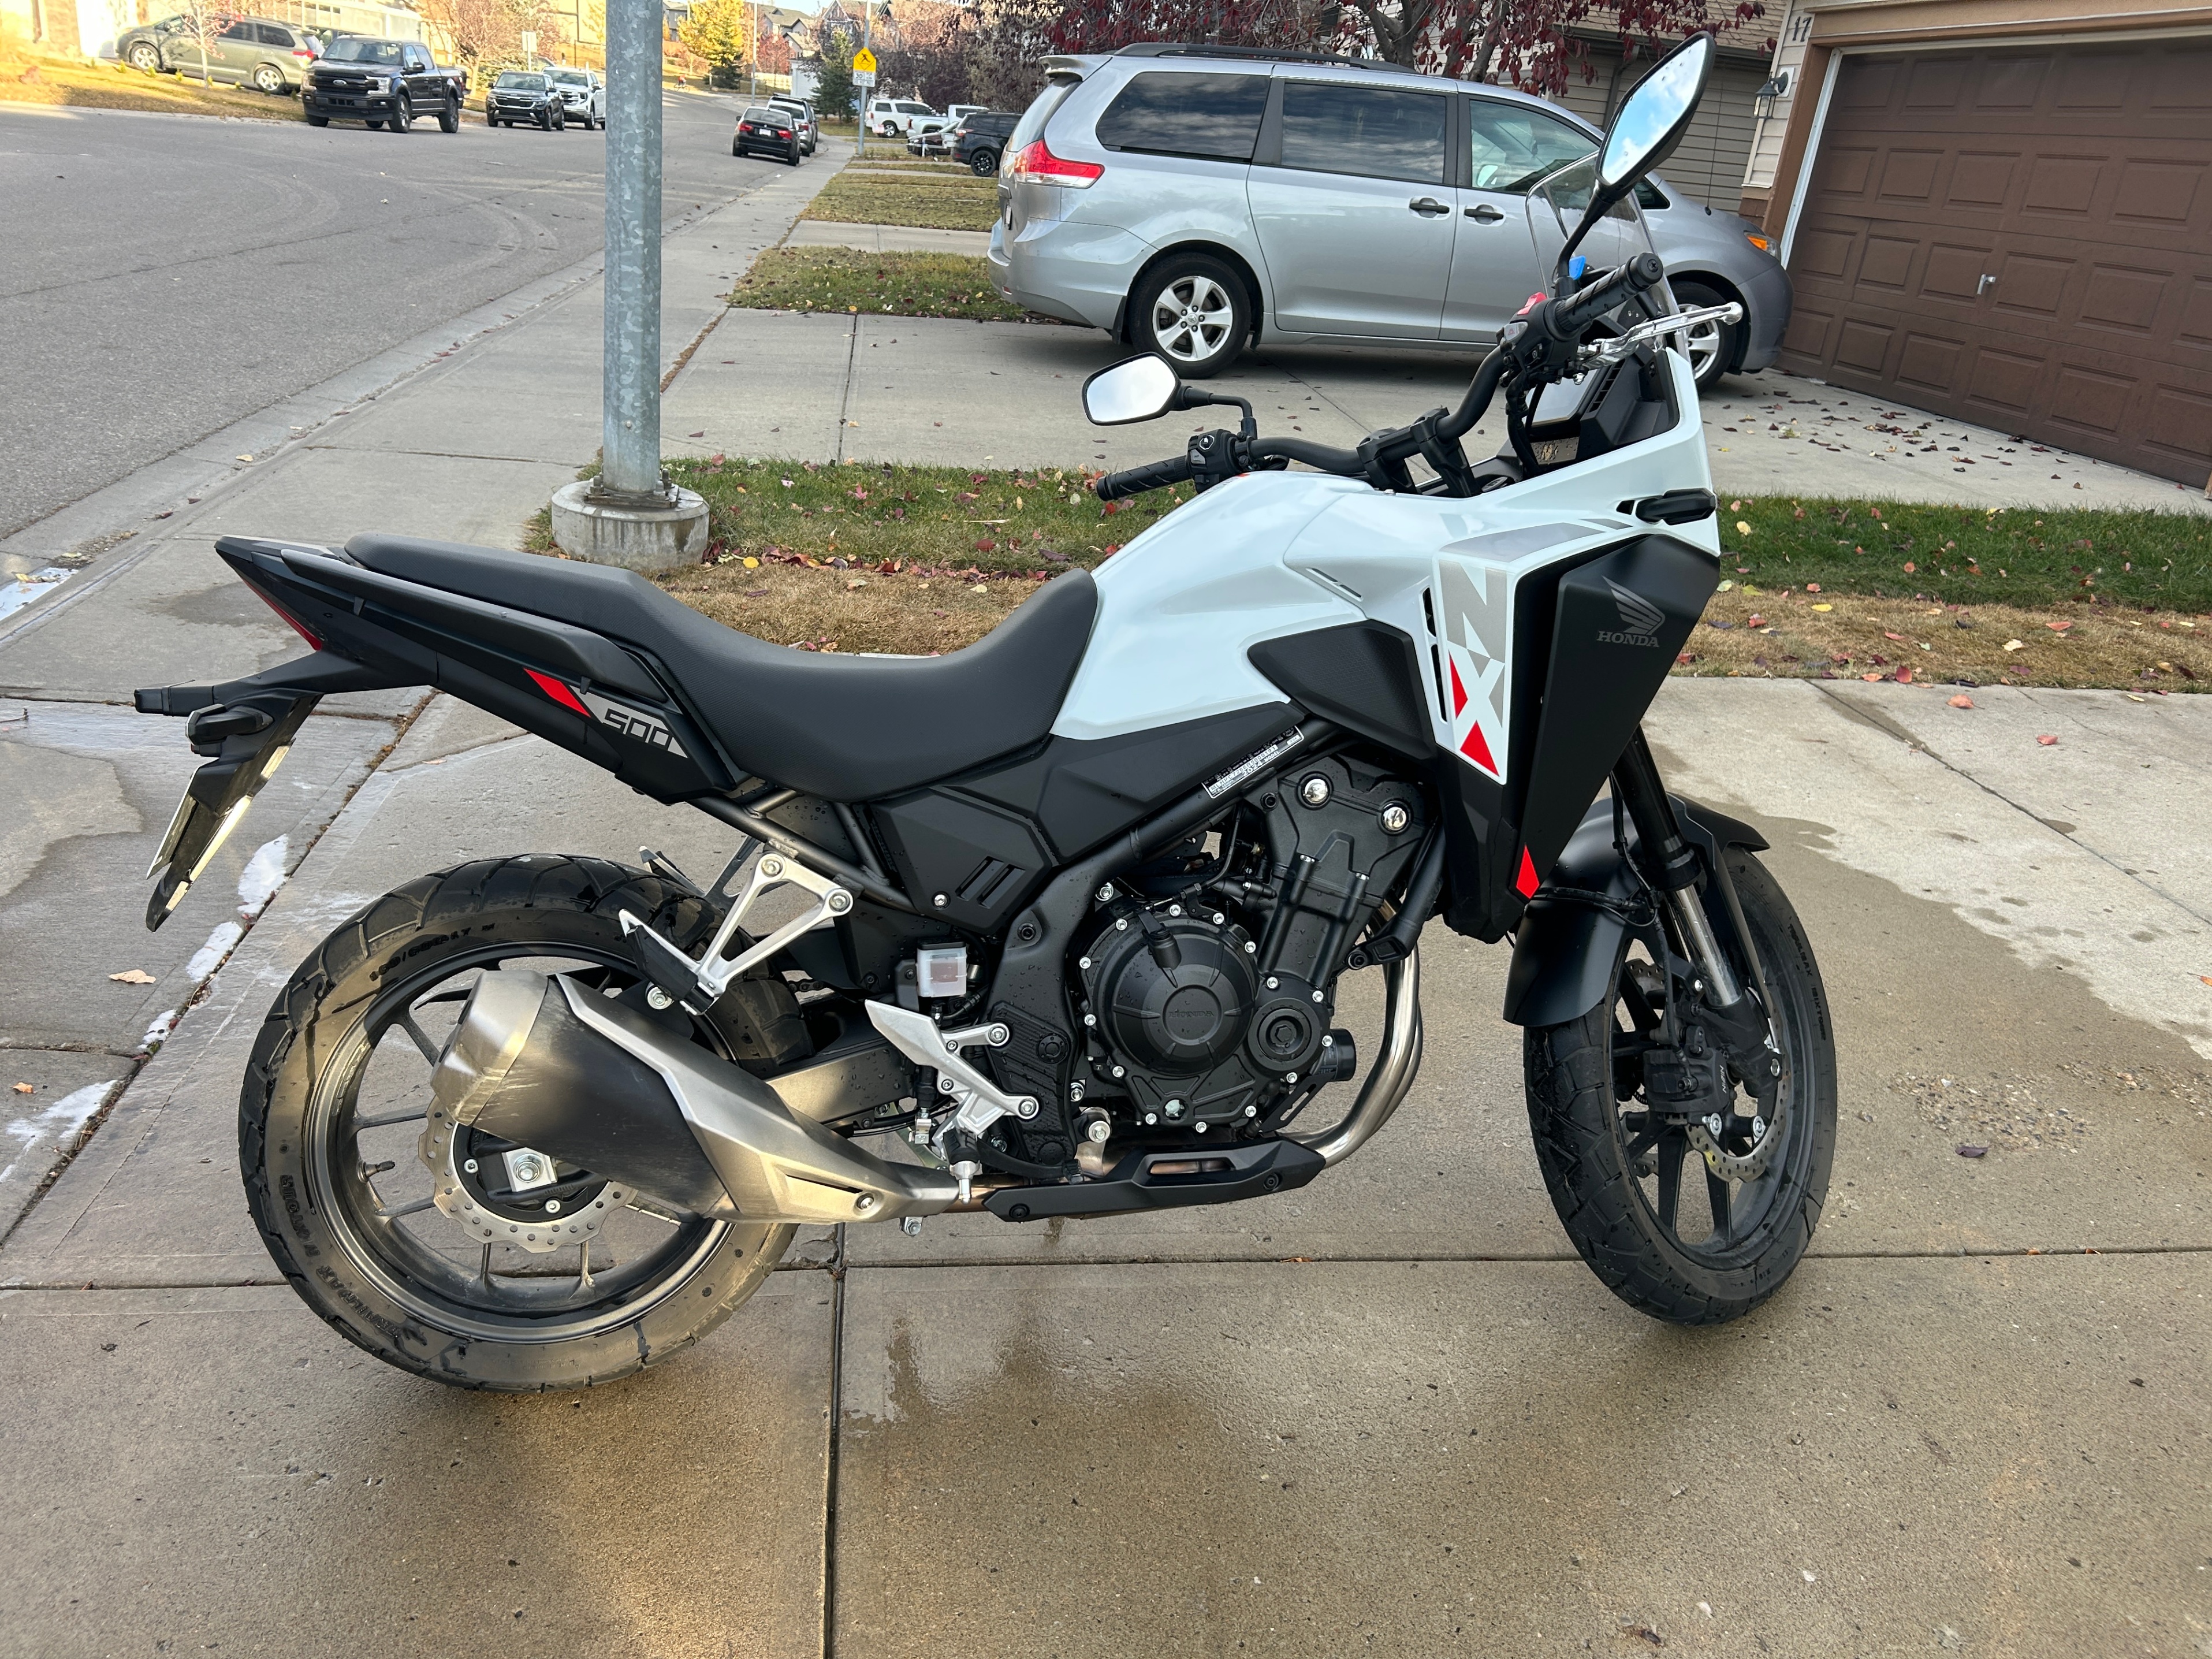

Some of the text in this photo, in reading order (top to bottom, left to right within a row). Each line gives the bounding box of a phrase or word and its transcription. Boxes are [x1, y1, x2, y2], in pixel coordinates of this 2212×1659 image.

[1792, 16, 1812, 43] 17
[1596, 631, 1659, 647] HONDA
[1439, 559, 1507, 778] NX
[604, 708, 672, 750] 500
[1242, 761, 1263, 777] 2024
[1264, 750, 1280, 763] MODEL
[1167, 1009, 1215, 1018] HONDA
[316, 1266, 401, 1338] TRAILMAX
